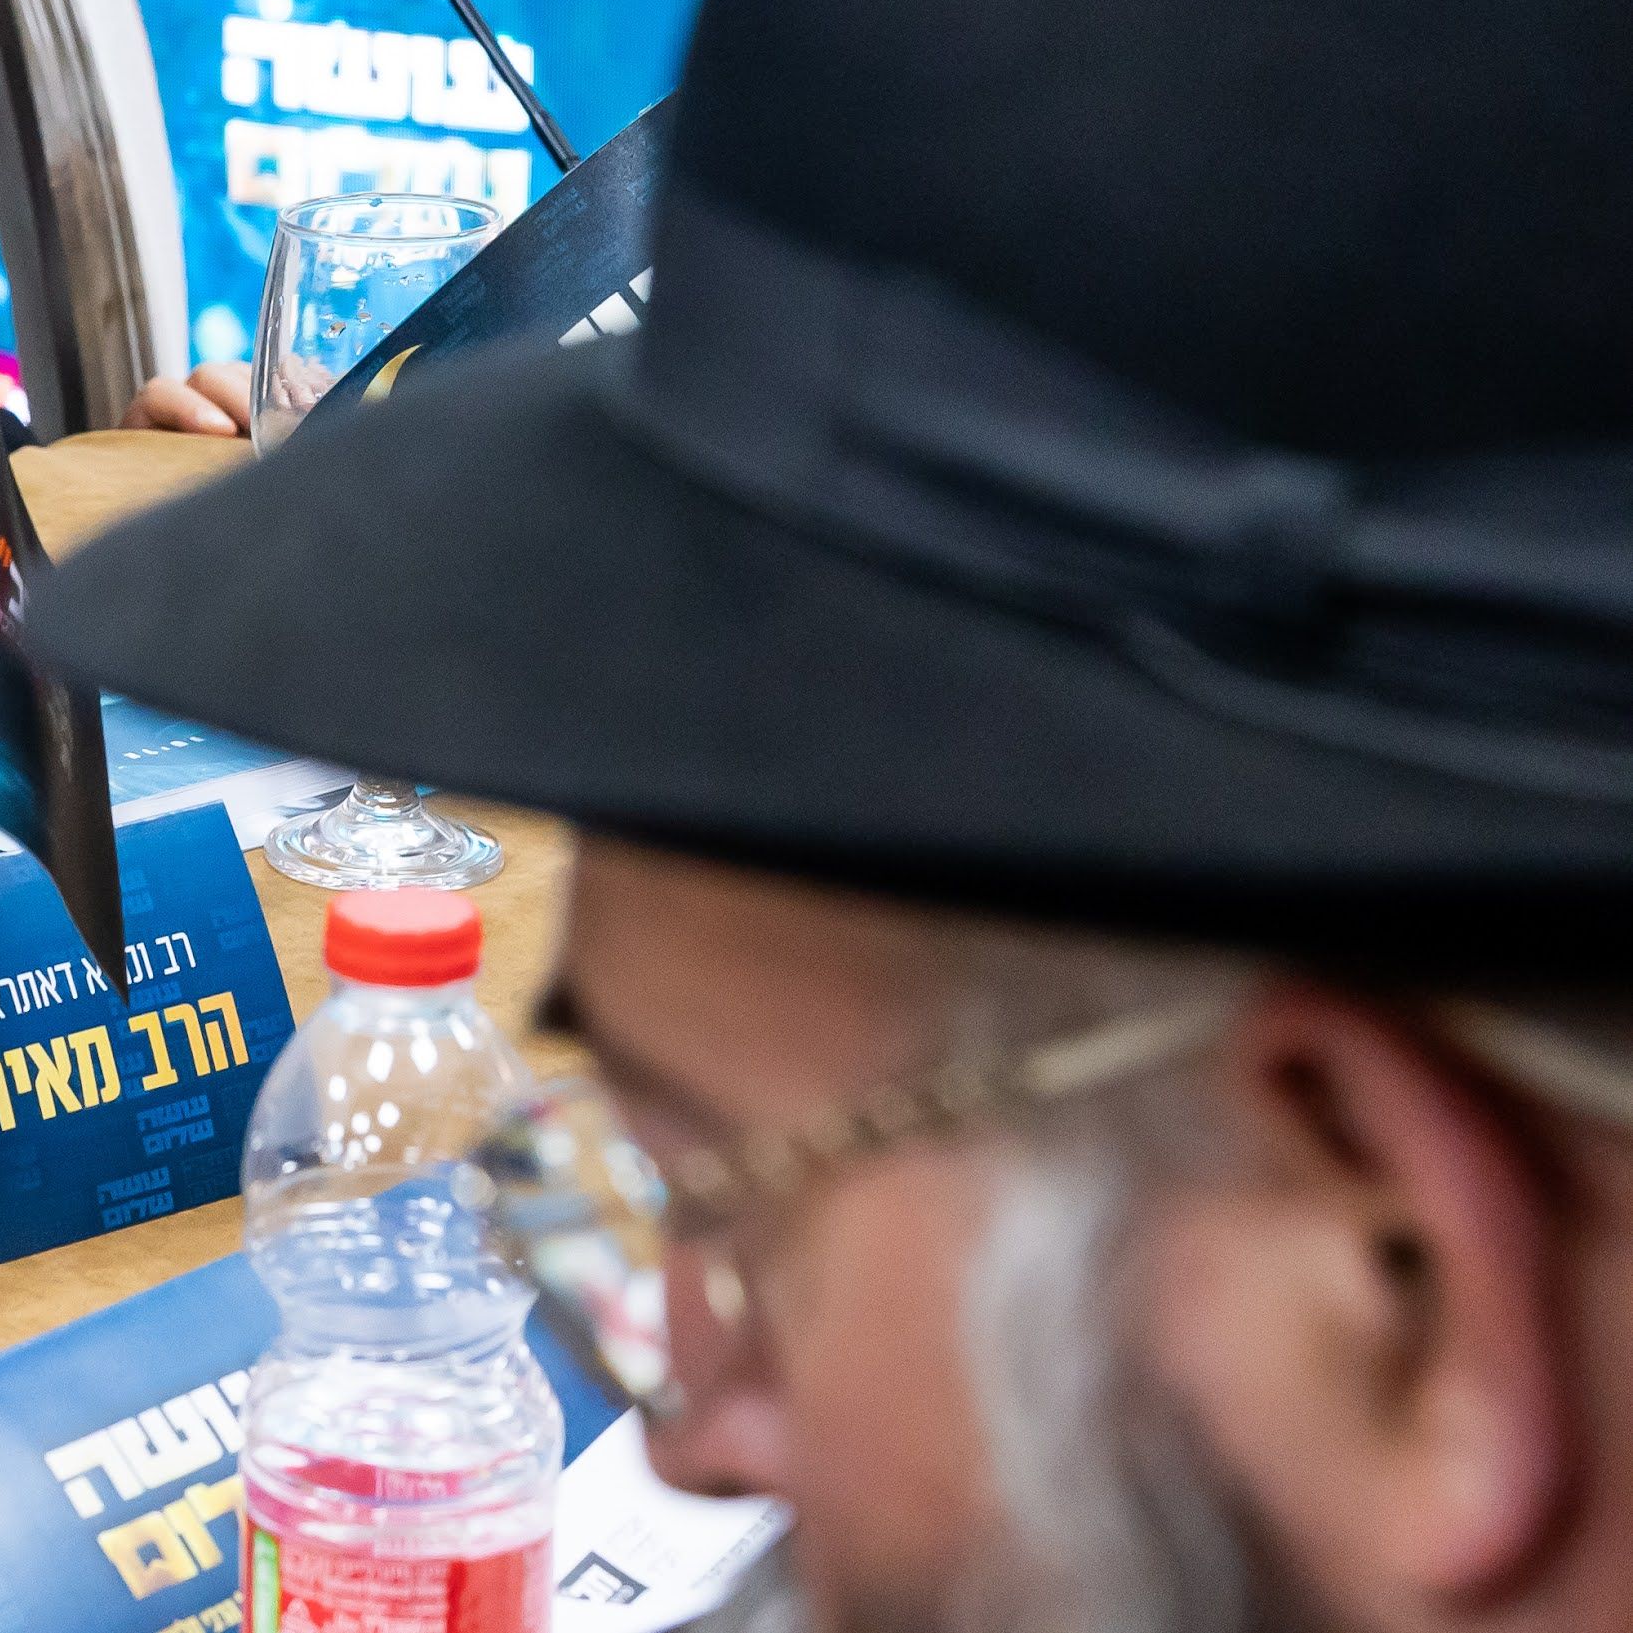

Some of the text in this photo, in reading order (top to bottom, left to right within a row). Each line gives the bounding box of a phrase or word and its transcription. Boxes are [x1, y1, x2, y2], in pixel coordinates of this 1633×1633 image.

[222, 14, 535, 135] עושה
[80, 941, 154, 995] ומא
[154, 931, 197, 976] רב
[128, 991, 251, 1092] הרב
[44, 1369, 251, 1519] ושה
